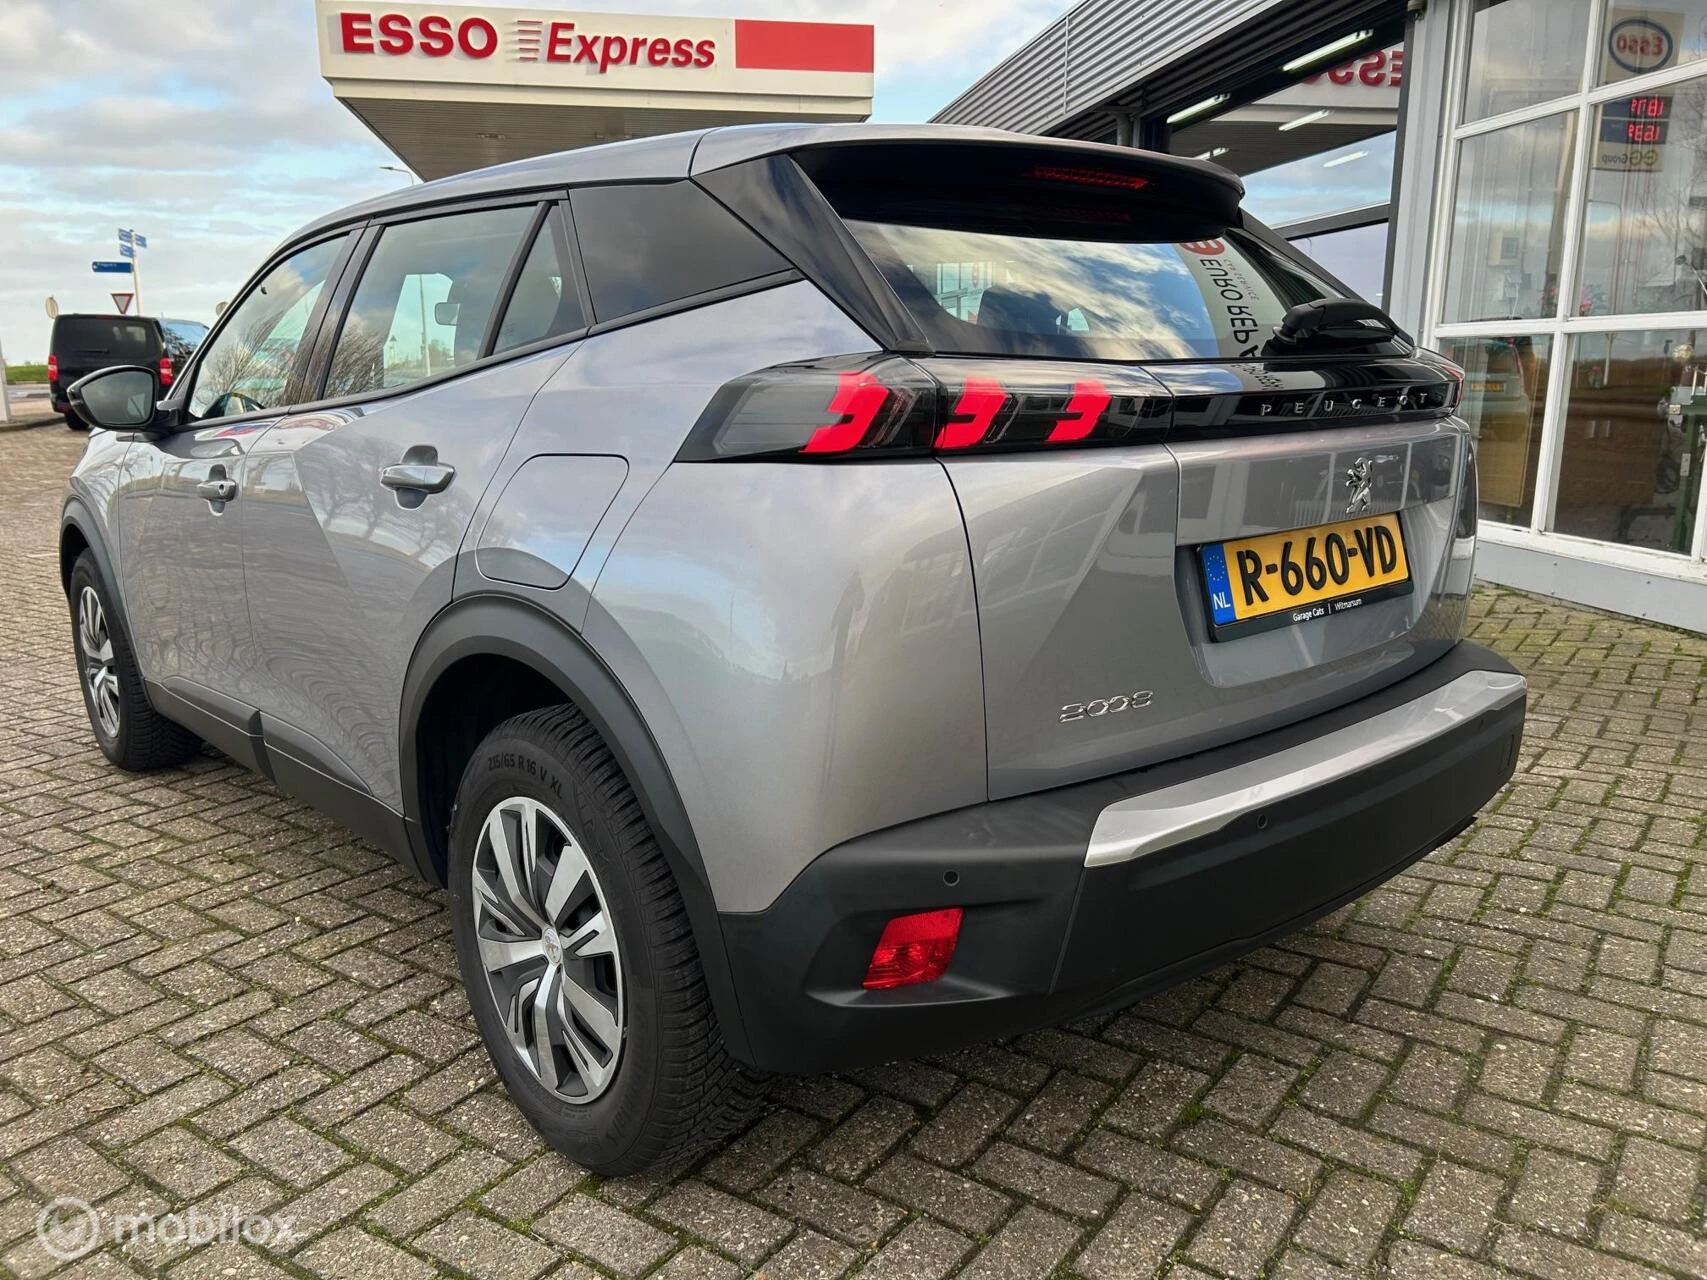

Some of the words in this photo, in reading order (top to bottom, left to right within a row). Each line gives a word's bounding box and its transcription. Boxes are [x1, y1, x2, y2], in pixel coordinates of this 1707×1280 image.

[340, 12, 498, 59] ESSO
[547, 22, 715, 73] Express
[1260, 392, 1428, 417] PEUGEOT
[1236, 526, 1397, 606] R-660-VD
[1213, 591, 1232, 610] NL
[1292, 610, 1313, 622] Garage
[1312, 607, 1325, 617] Cats
[1060, 690, 1153, 722] 2008
[487, 752, 516, 771] 215/65
[517, 756, 526, 770] R
[526, 757, 537, 776] 16
[550, 775, 563, 799] XL
